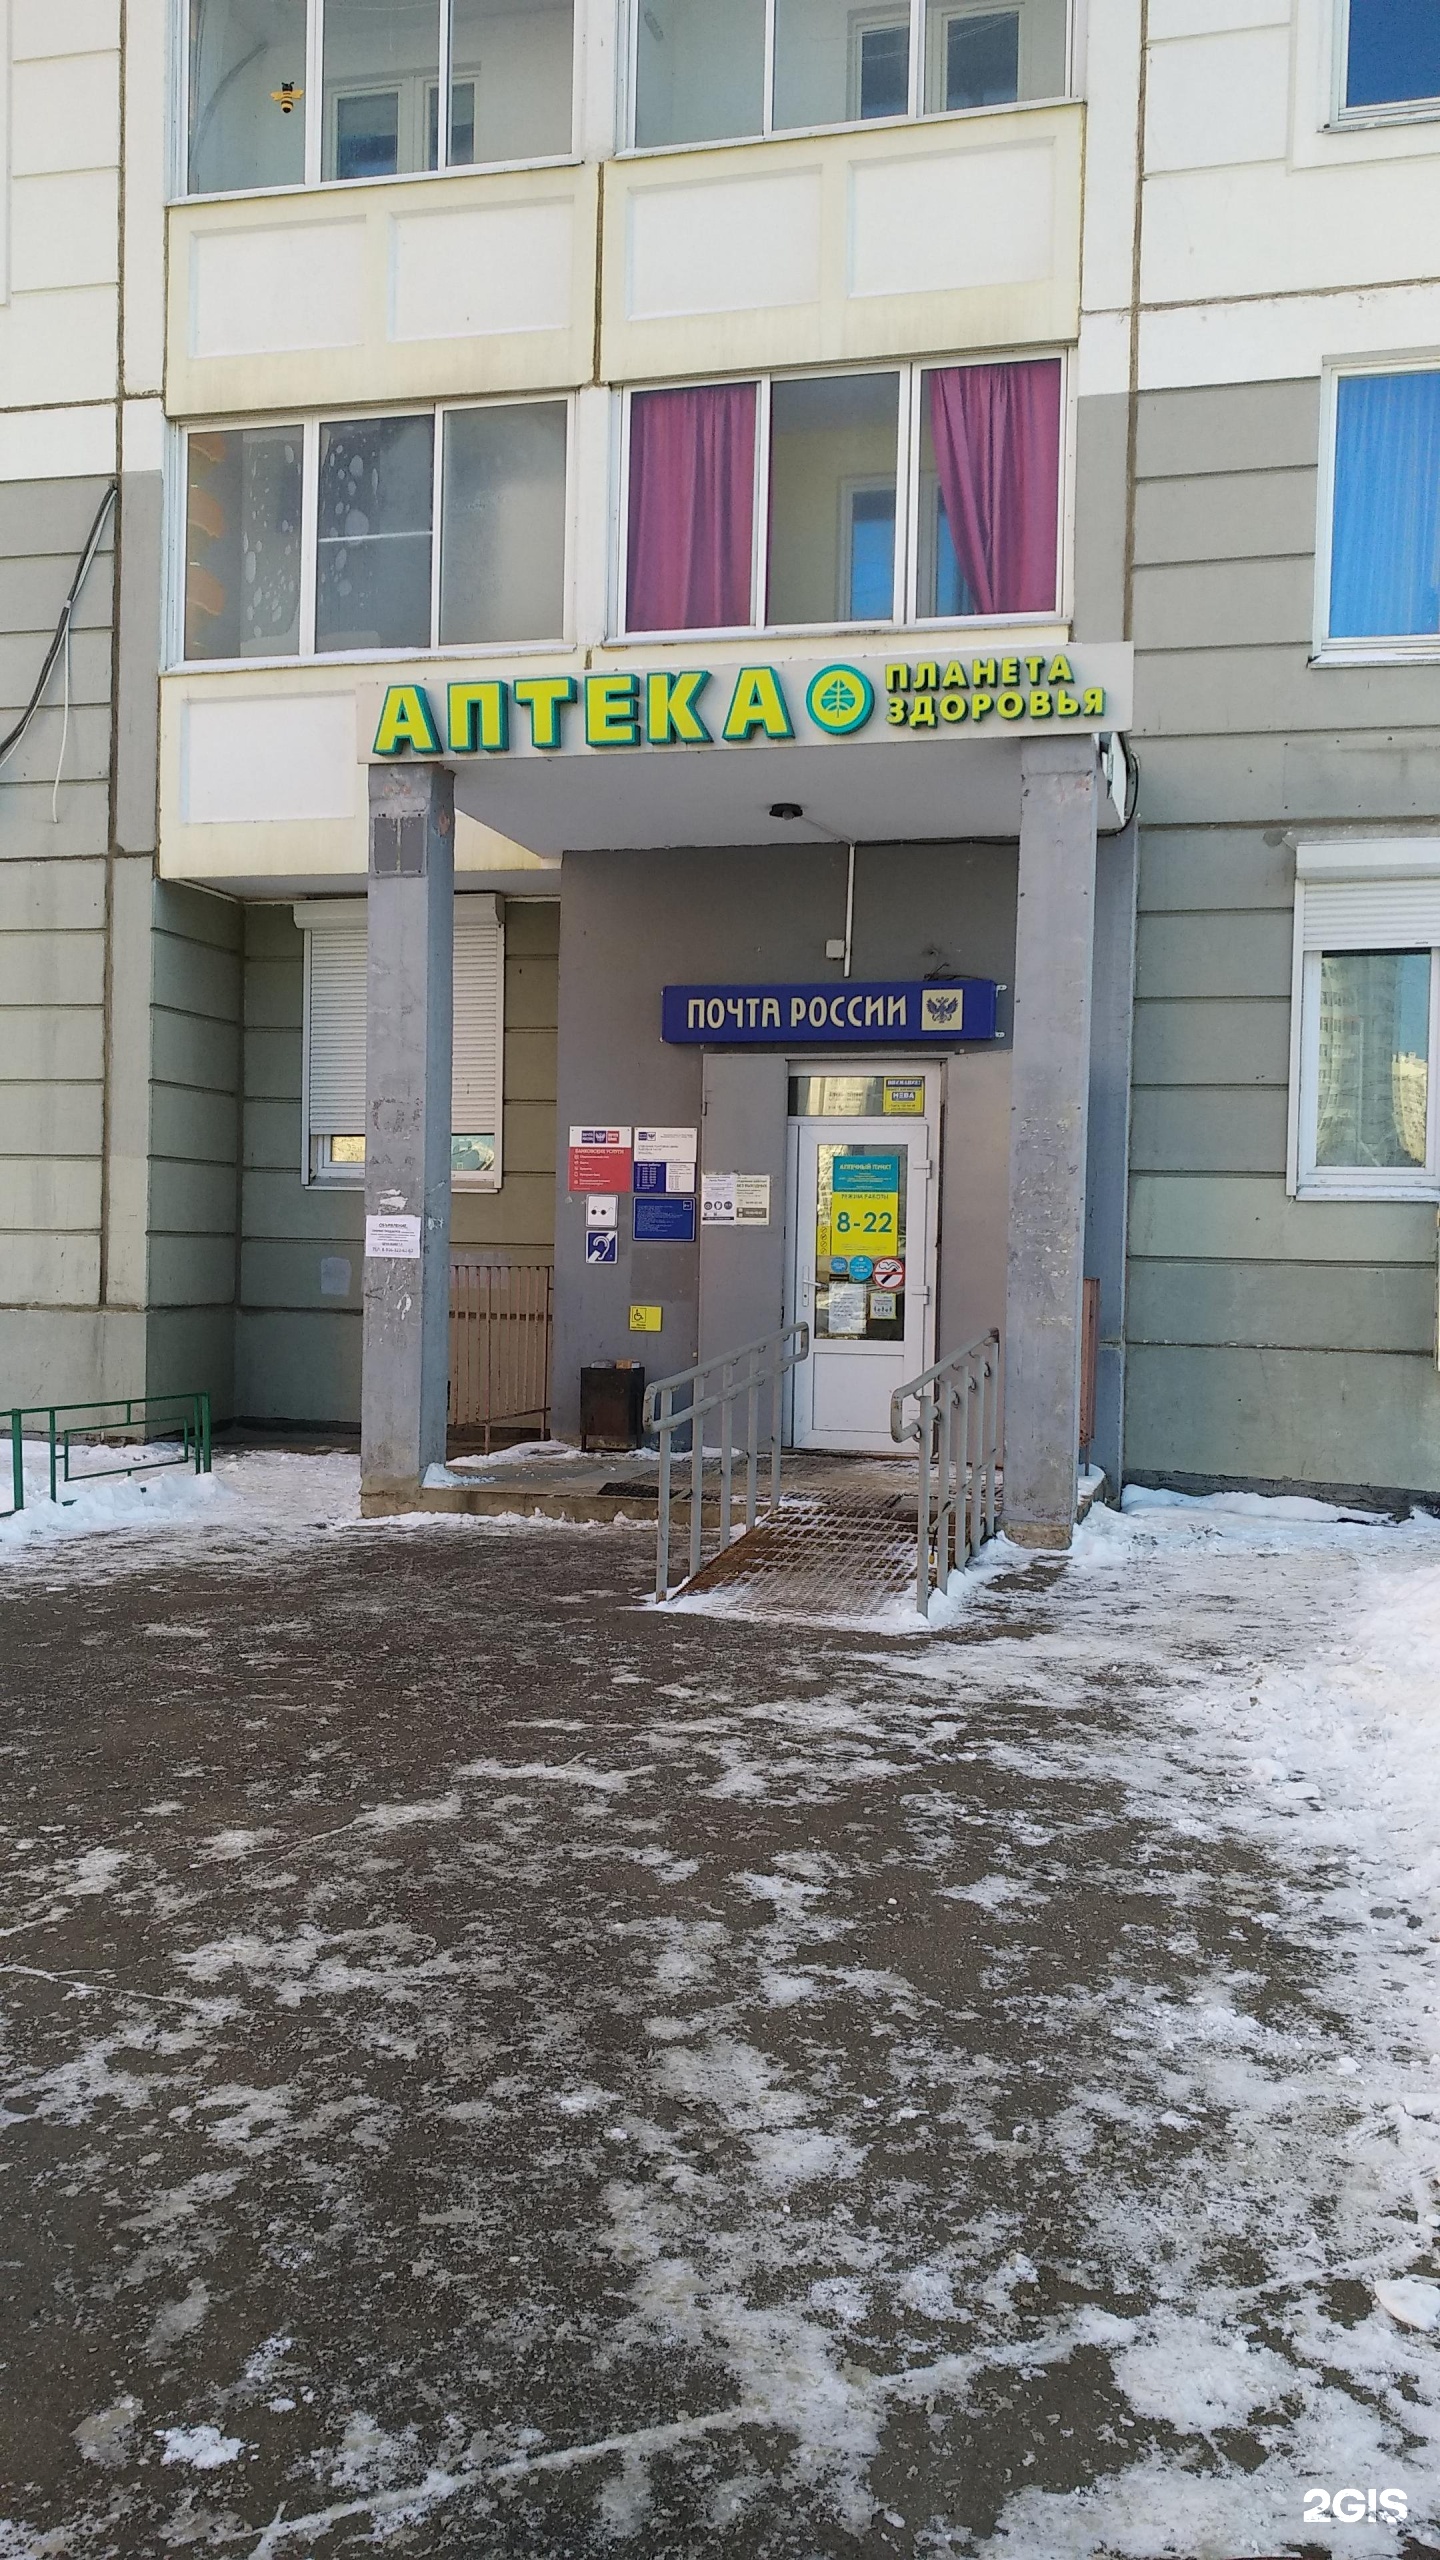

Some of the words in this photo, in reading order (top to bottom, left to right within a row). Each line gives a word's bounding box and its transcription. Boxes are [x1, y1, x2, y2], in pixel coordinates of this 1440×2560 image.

[885, 653, 1075, 691] ПЛАНЕТА
[372, 666, 796, 756] АПТЕКА
[886, 687, 1106, 729] ЗДОРОВЬЯ
[687, 998, 781, 1029] ПОЧТА
[790, 994, 907, 1028] РОССИИ
